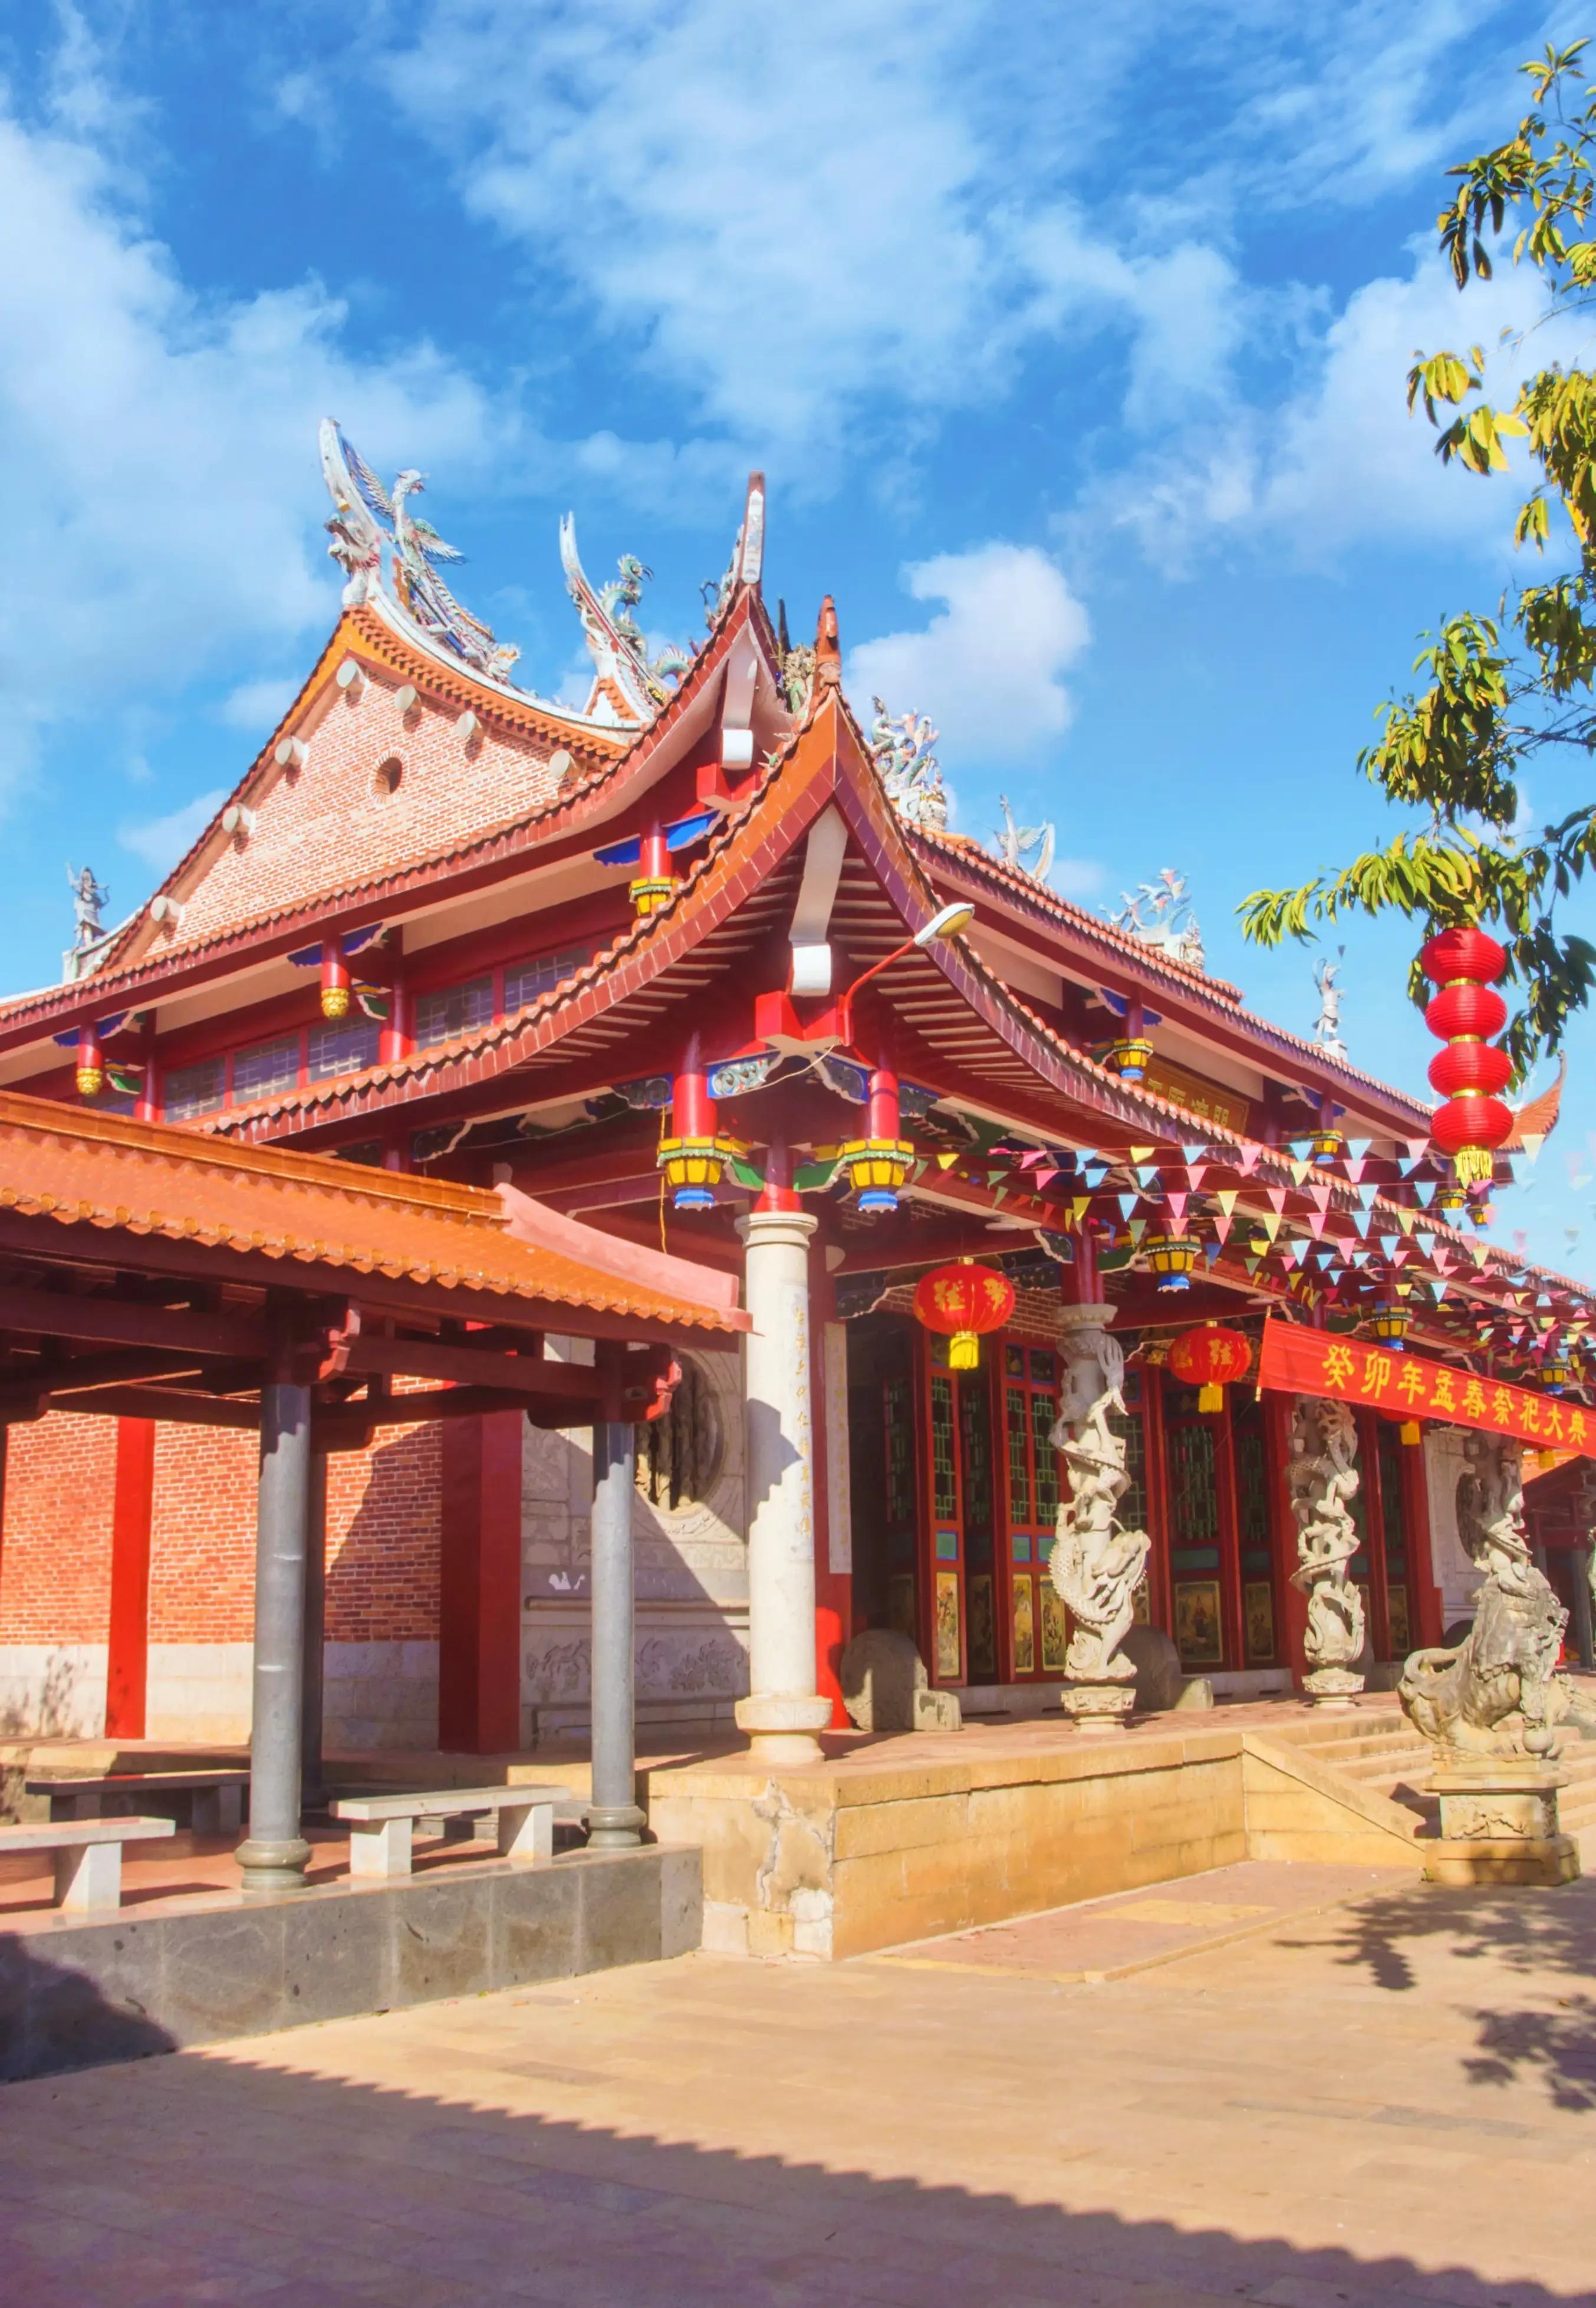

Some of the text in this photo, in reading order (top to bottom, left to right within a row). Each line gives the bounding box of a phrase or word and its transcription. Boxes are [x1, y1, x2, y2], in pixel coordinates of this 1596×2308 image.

[1322, 1344, 1588, 1447] 癸卯年孟春祭祀大典
